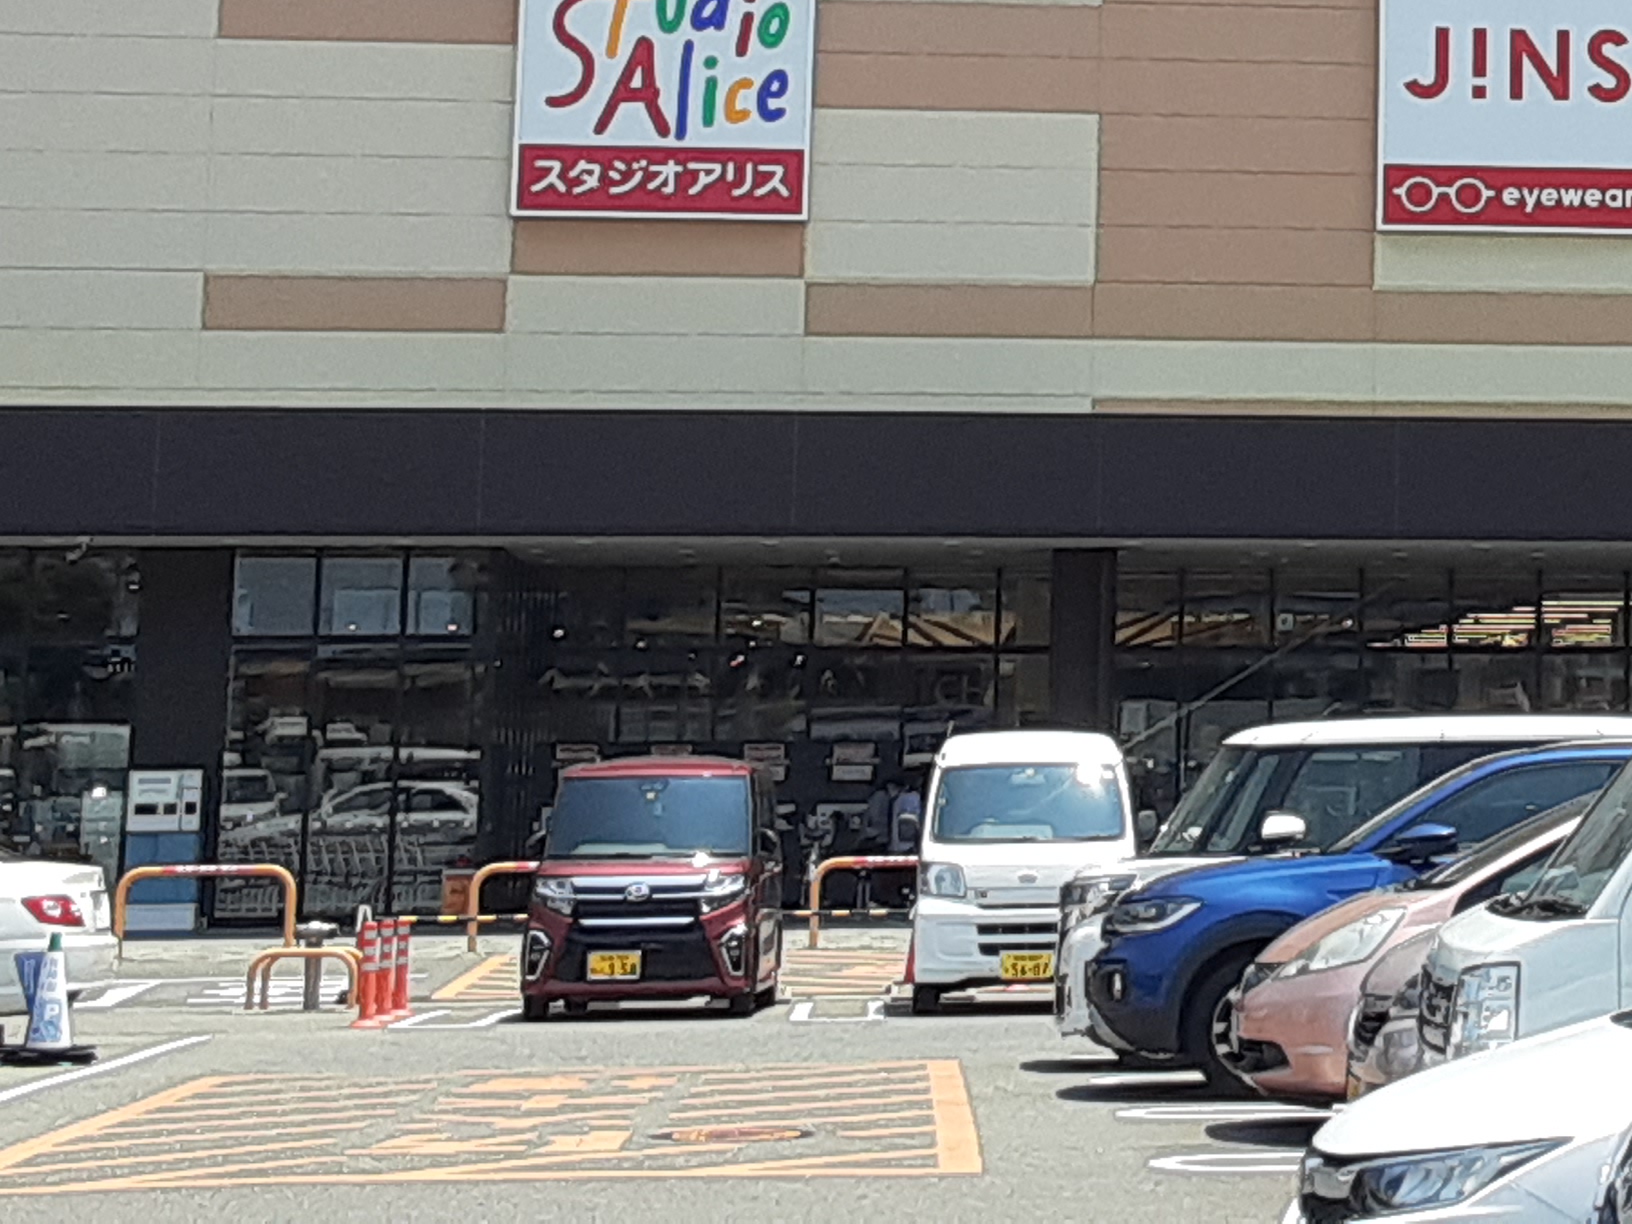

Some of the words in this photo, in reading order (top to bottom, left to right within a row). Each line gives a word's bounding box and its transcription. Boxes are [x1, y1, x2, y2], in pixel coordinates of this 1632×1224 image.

[529, 159, 790, 197] スタジオアリス
